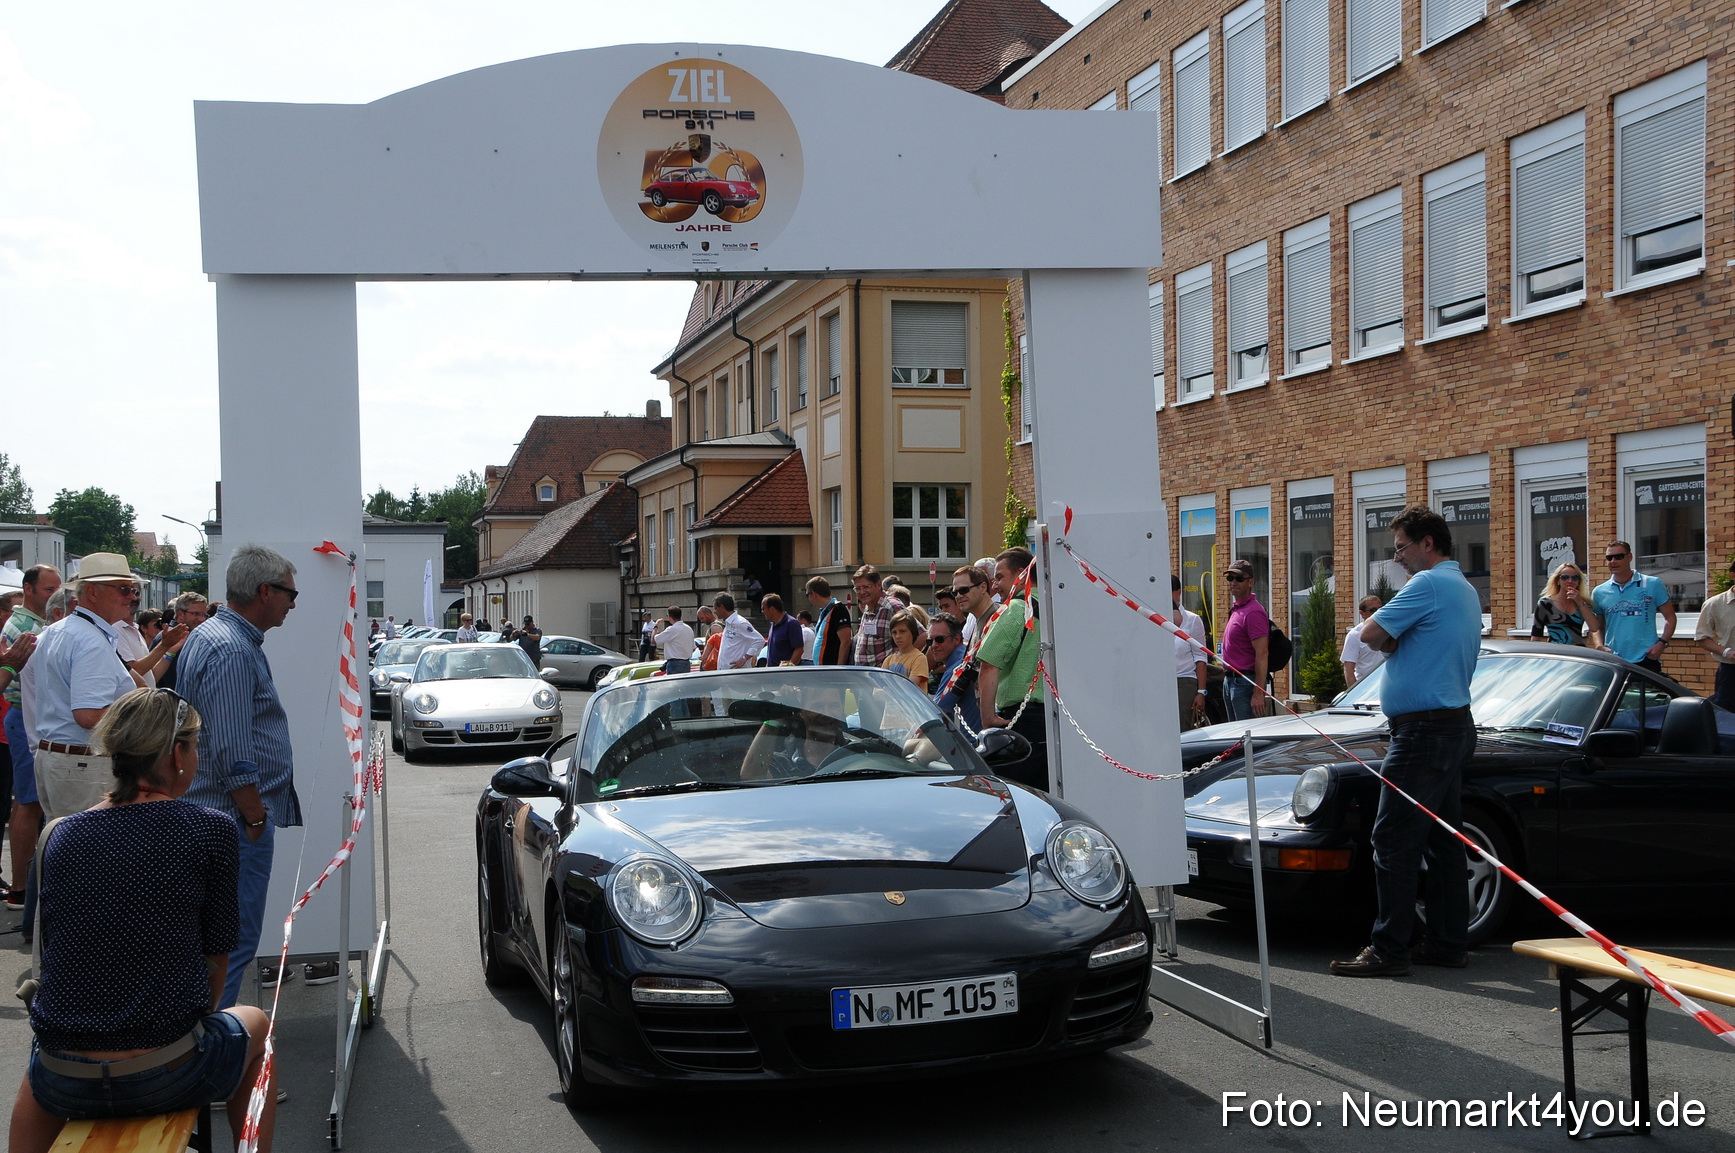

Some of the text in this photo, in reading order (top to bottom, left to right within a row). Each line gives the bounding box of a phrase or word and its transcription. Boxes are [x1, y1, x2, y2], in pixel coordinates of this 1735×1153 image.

[668, 69, 731, 103] ZIEL
[643, 110, 755, 120] PORSCHE
[685, 120, 714, 130] 911
[675, 224, 732, 232] JAHRE
[650, 242, 688, 250] MEILENSTEIN
[1658, 494, 1701, 503] Nürnber
[1550, 504, 1585, 512] Nürnber
[470, 724, 484, 732] LAU
[495, 723, 508, 731] 911
[854, 981, 997, 1023] N MF 105
